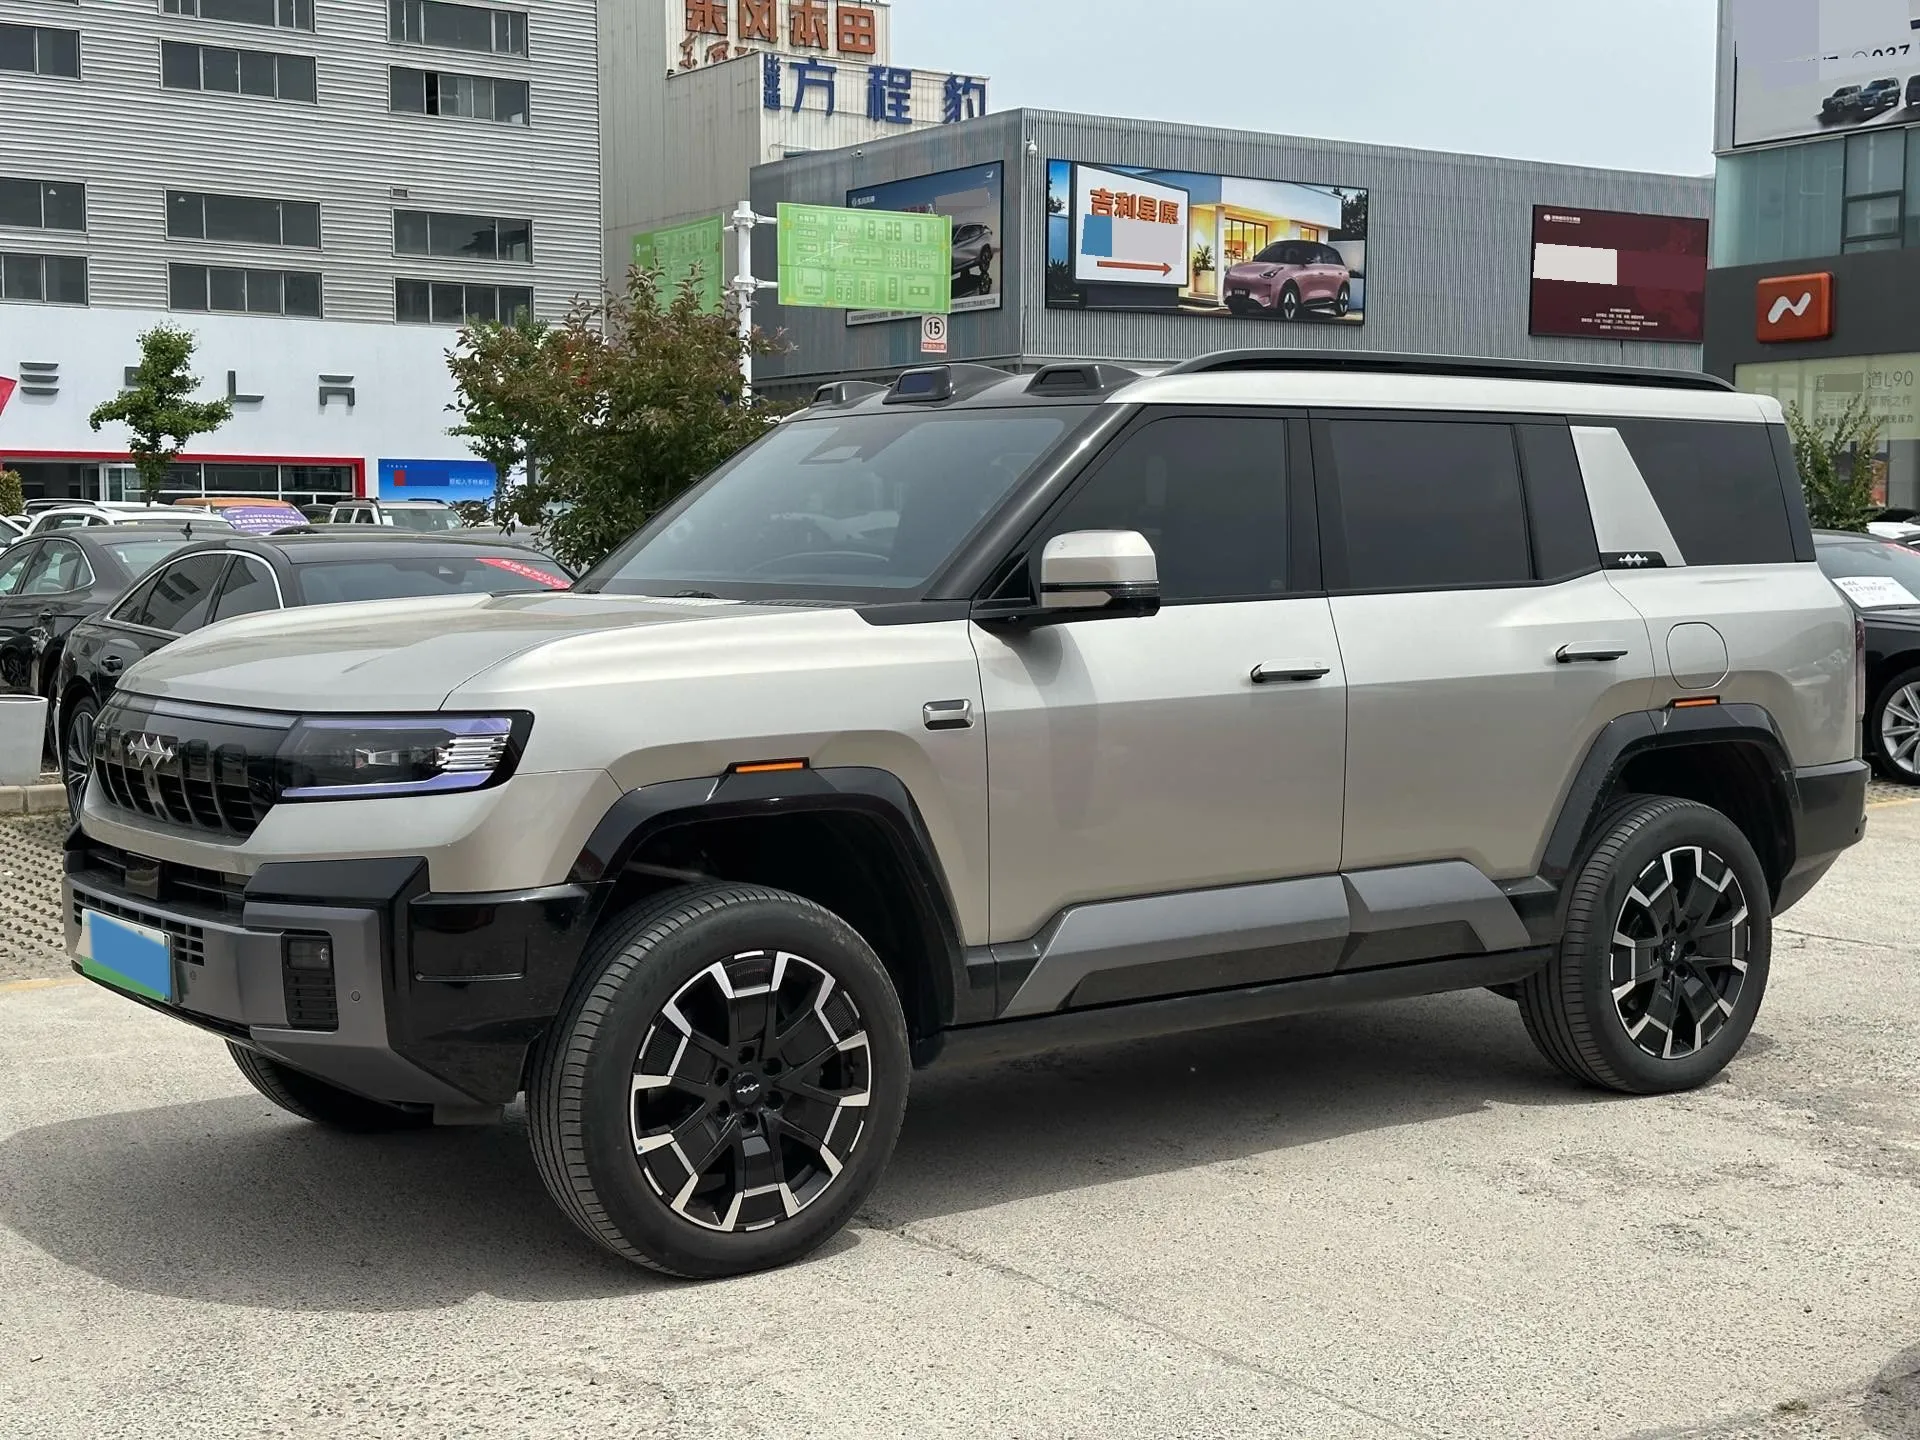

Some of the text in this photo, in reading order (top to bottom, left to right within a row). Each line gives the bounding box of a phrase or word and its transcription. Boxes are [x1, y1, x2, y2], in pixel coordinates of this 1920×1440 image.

[789, 56, 986, 124] 方程豹
[1090, 188, 1179, 225] 吉利星愿
[928, 321, 941, 335] 15
